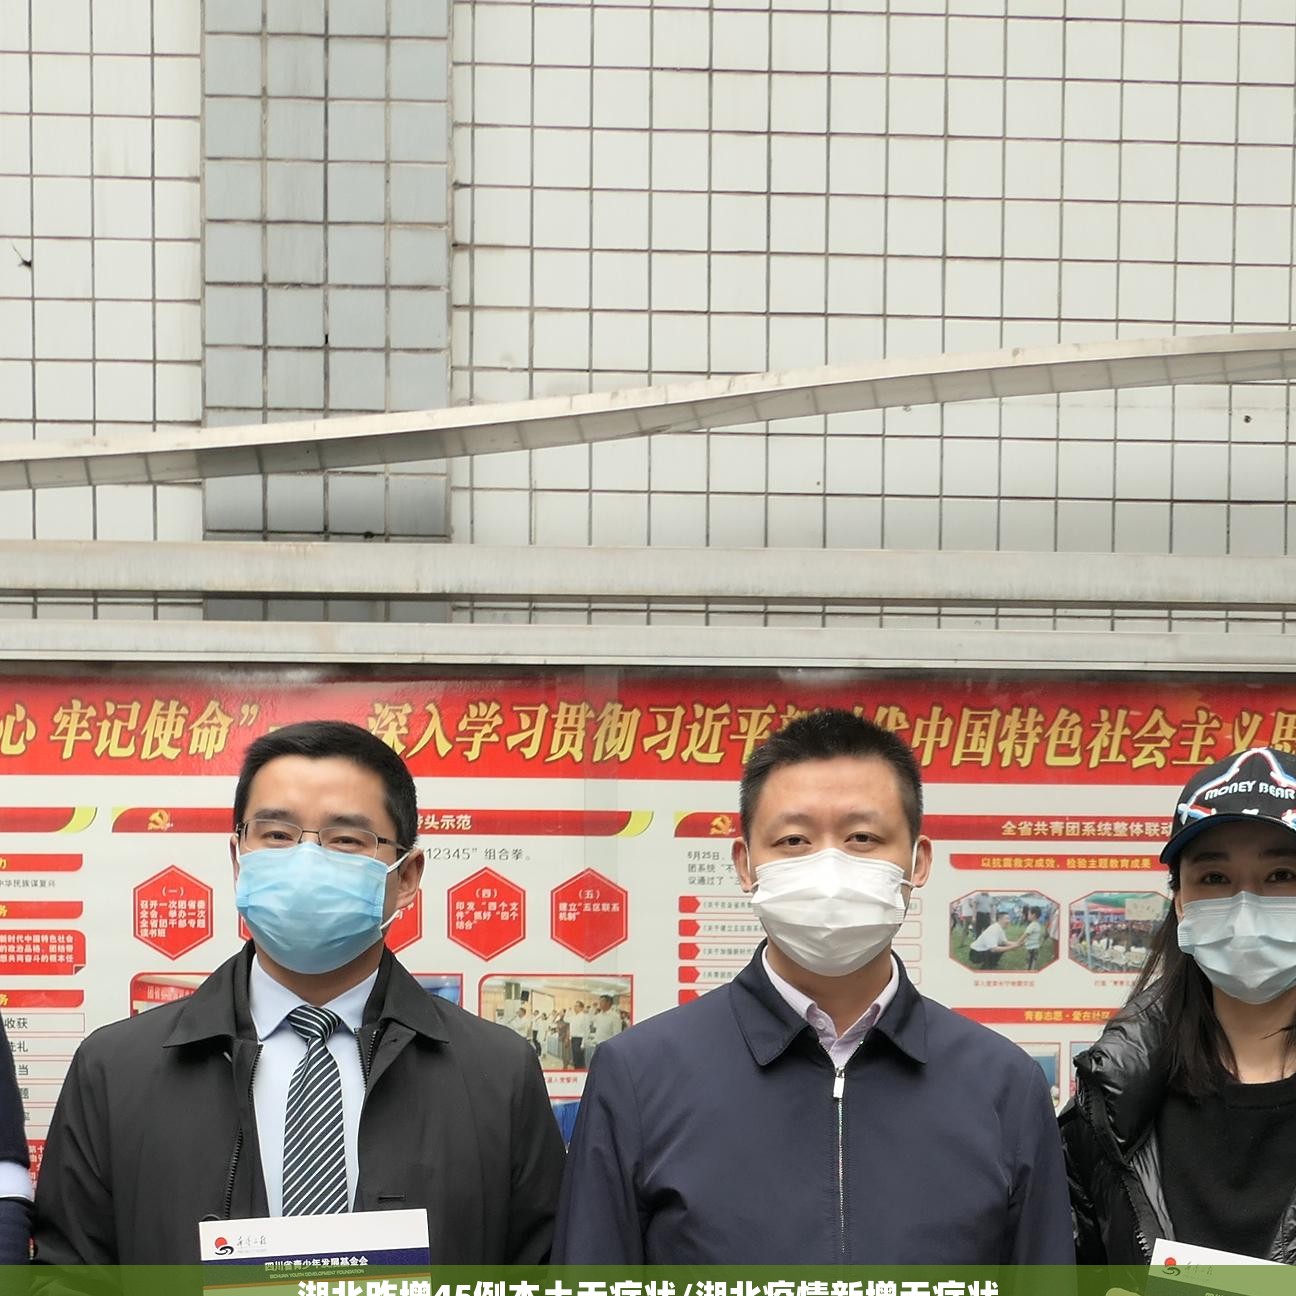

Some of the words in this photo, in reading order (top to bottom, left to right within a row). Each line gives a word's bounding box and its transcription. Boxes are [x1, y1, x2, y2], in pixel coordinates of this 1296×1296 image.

[1205, 780, 1256, 801] MONEY
[1259, 783, 1296, 800] BEAR
[3, 1017, 28, 1029] 收获
[18, 1064, 29, 1076] 当
[264, 1256, 369, 1272] 四川省青少年发展基金会
